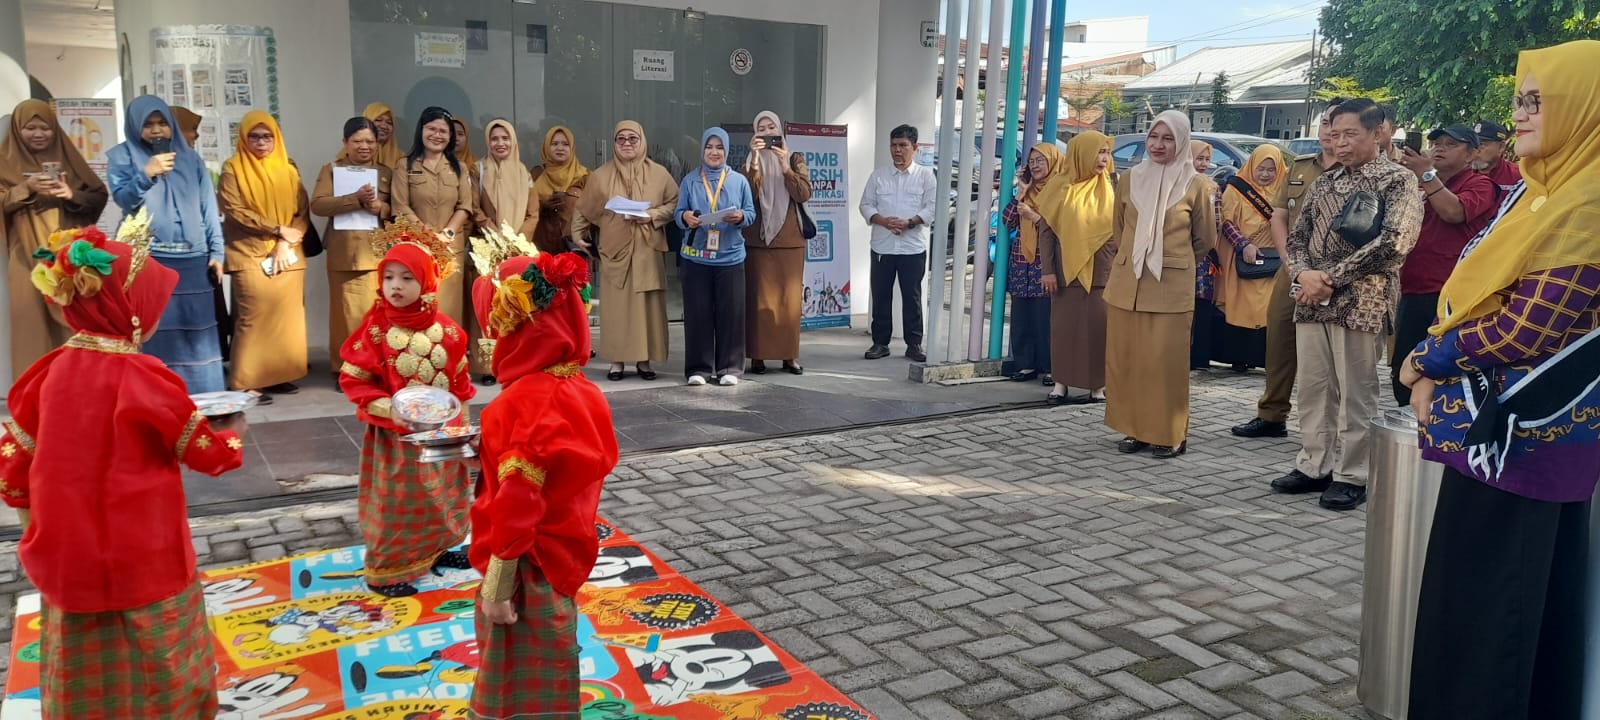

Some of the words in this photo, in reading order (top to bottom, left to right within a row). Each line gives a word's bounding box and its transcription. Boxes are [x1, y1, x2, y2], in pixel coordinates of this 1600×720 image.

[643, 56, 665, 65] Ruang
[641, 65, 667, 73] Literasi
[801, 152, 838, 167] PMB
[807, 168, 843, 182] RSIH
[810, 180, 833, 191] ANPA
[683, 245, 717, 259] ACHER
[355, 624, 476, 657] FEEL
